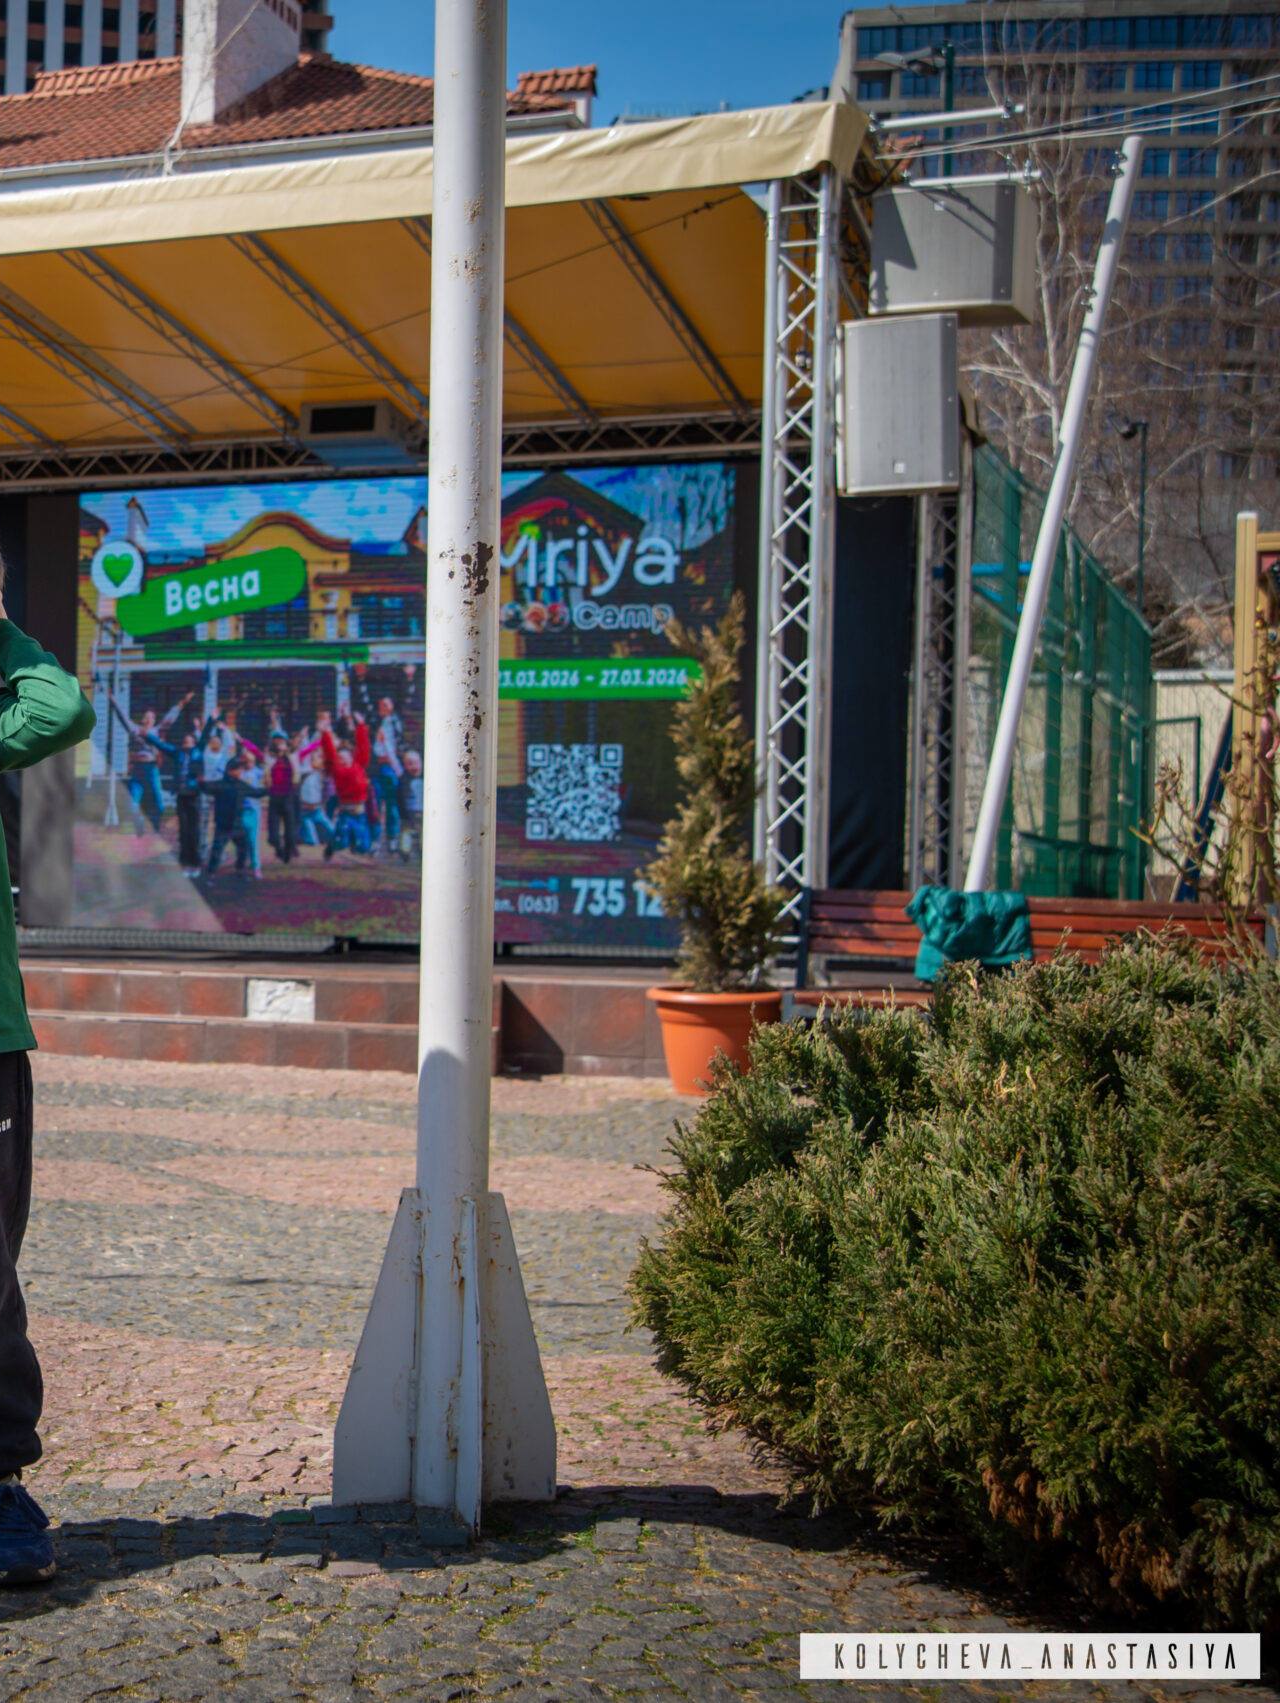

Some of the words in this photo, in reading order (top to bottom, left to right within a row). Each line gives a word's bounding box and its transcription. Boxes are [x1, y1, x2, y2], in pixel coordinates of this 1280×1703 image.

[164, 569, 260, 617] Весна
[572, 600, 674, 634] Camp
[599, 667, 687, 687] 27.03.2026
[518, 894, 558, 916] (063)
[571, 877, 626, 917] 735
